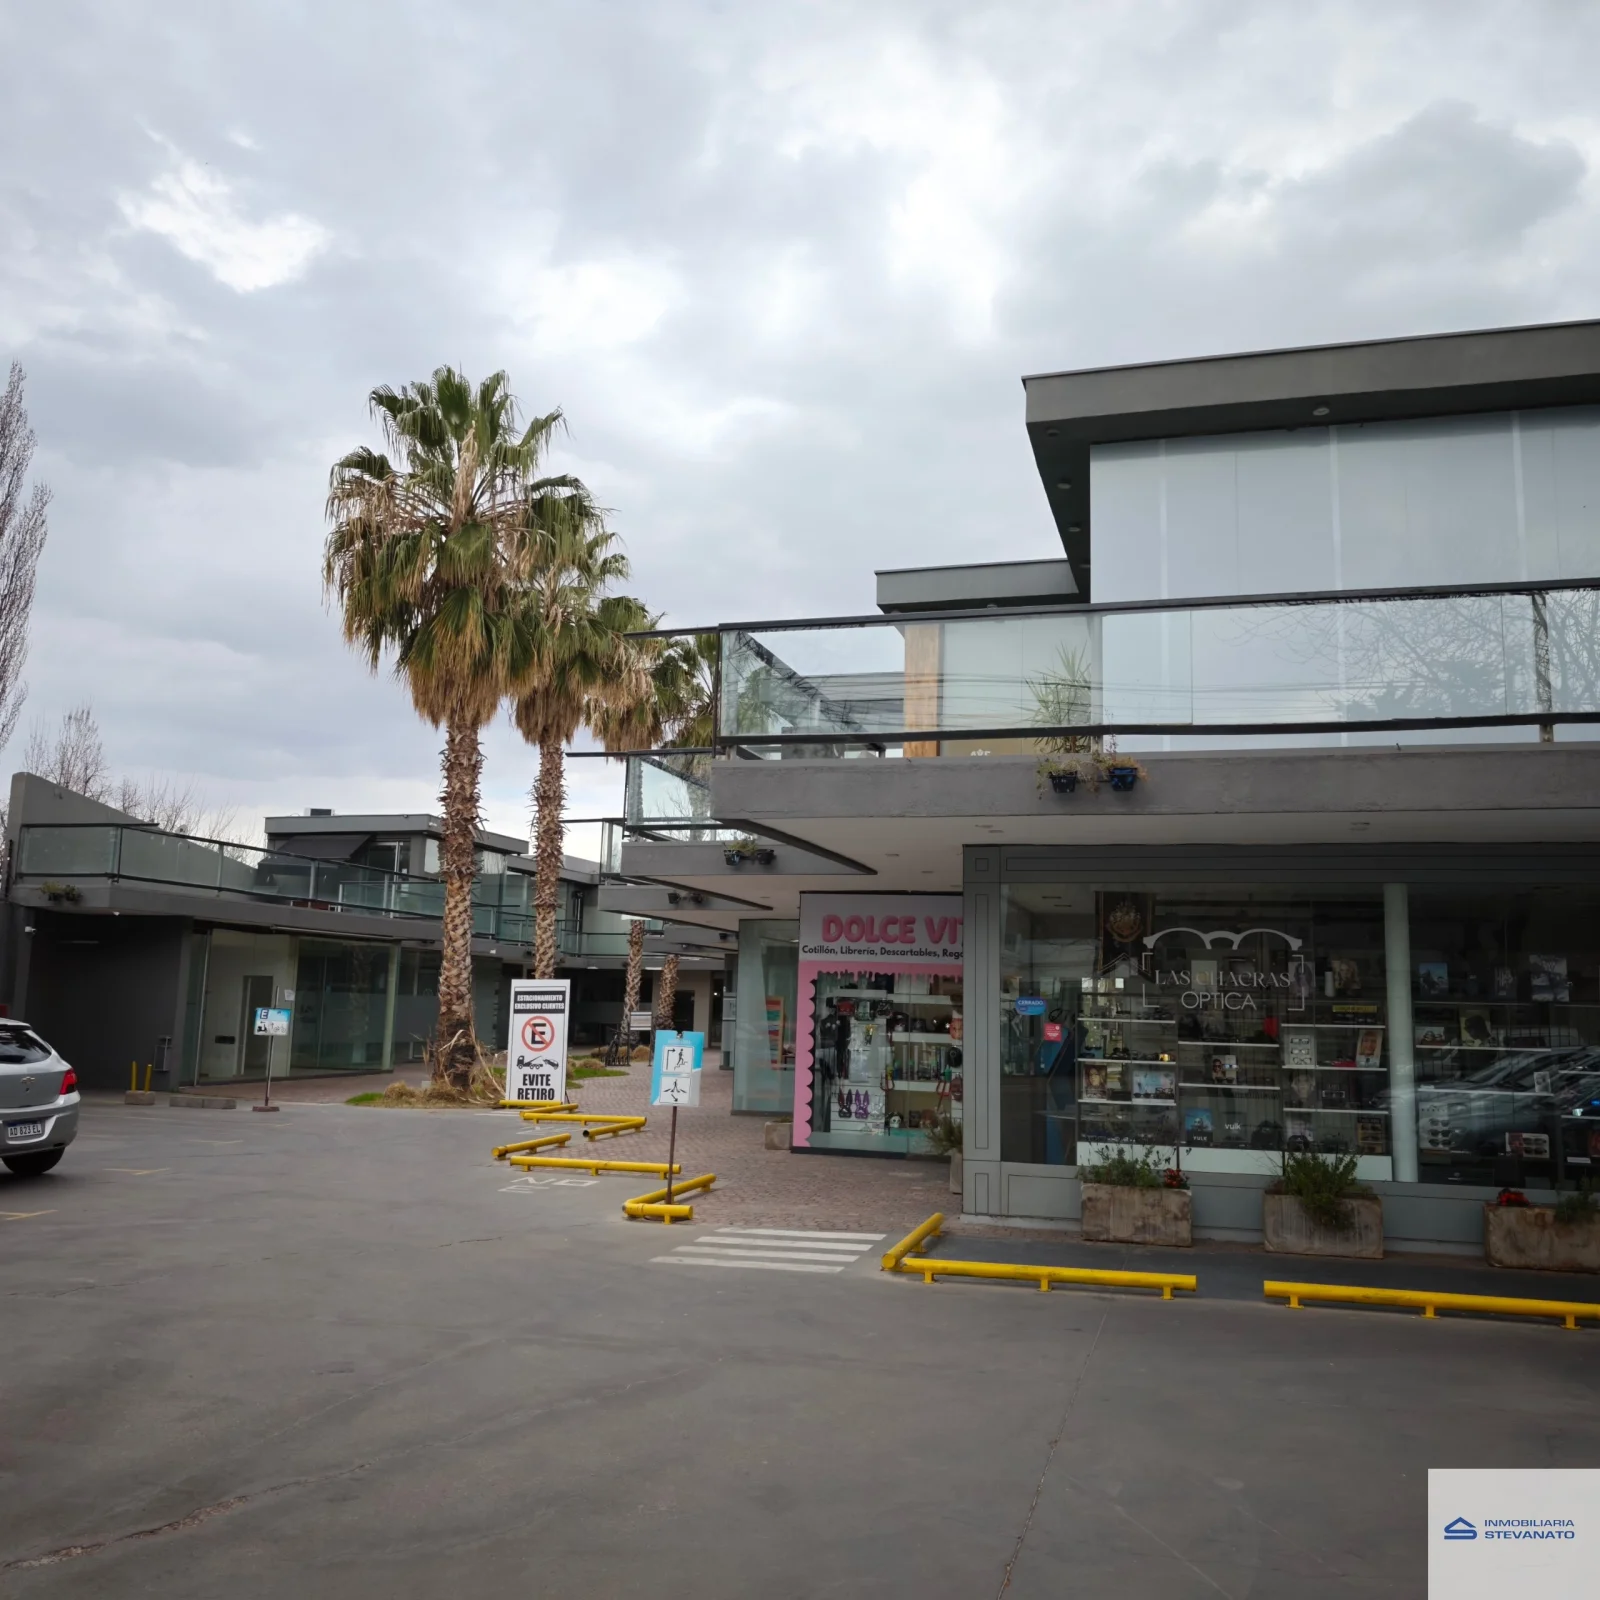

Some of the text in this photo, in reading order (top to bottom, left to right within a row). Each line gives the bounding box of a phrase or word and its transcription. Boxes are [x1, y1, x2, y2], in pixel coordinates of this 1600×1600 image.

[822, 914, 916, 944] DOLCE
[802, 945, 838, 955] Cotillón,
[840, 946, 878, 956] Librería,
[880, 947, 940, 958] Descartables,
[1155, 969, 1291, 988] LAS CHACRAS
[517, 994, 563, 1002] ESTACIONAMIENTO
[1181, 991, 1257, 1011] OPTICA
[514, 1002, 565, 1010] EXCLUSIVO CLIENTES
[531, 1023, 547, 1044] E
[522, 1074, 551, 1086] EVITE
[517, 1088, 555, 1101] RETIRO
